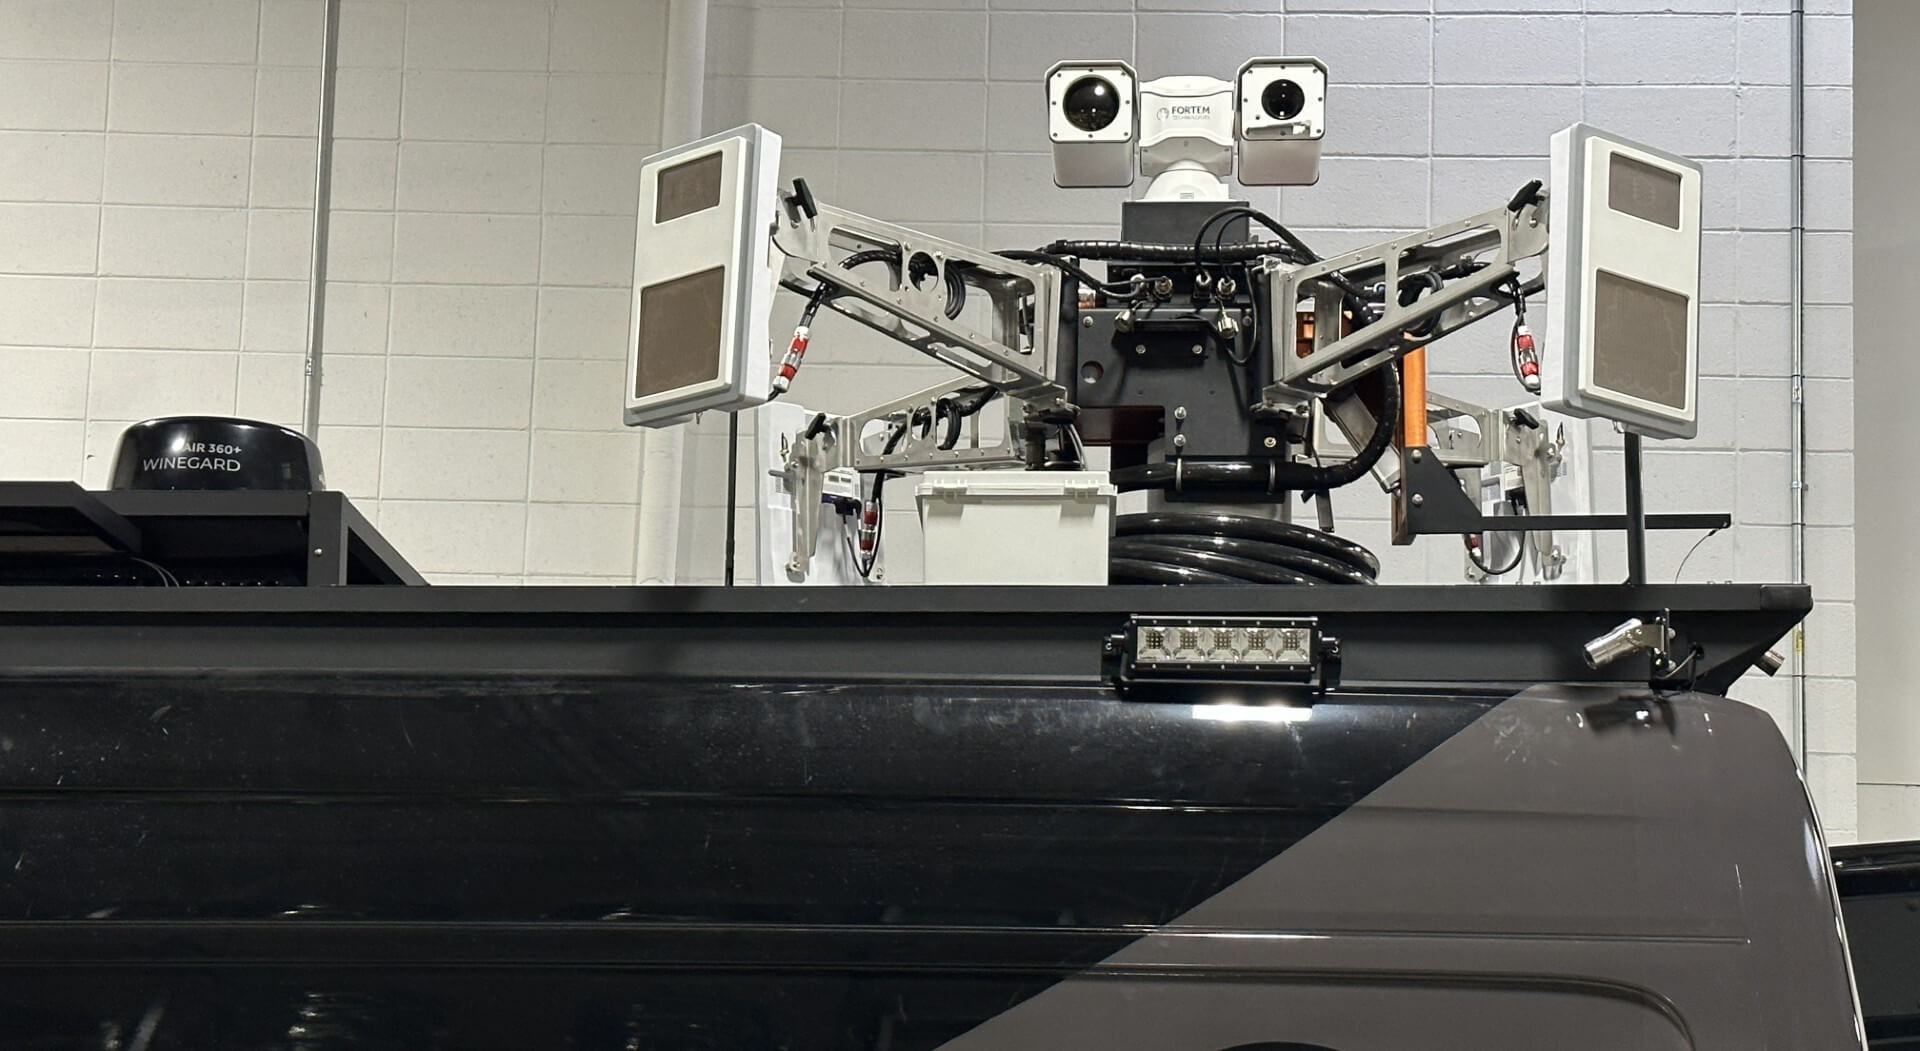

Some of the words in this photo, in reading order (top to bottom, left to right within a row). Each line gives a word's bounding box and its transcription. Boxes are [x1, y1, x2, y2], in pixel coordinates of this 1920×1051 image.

[1171, 105, 1210, 114] FORTEM
[183, 442, 206, 453] AIR
[208, 443, 242, 455] 360+
[143, 456, 241, 472] WINEGARD
